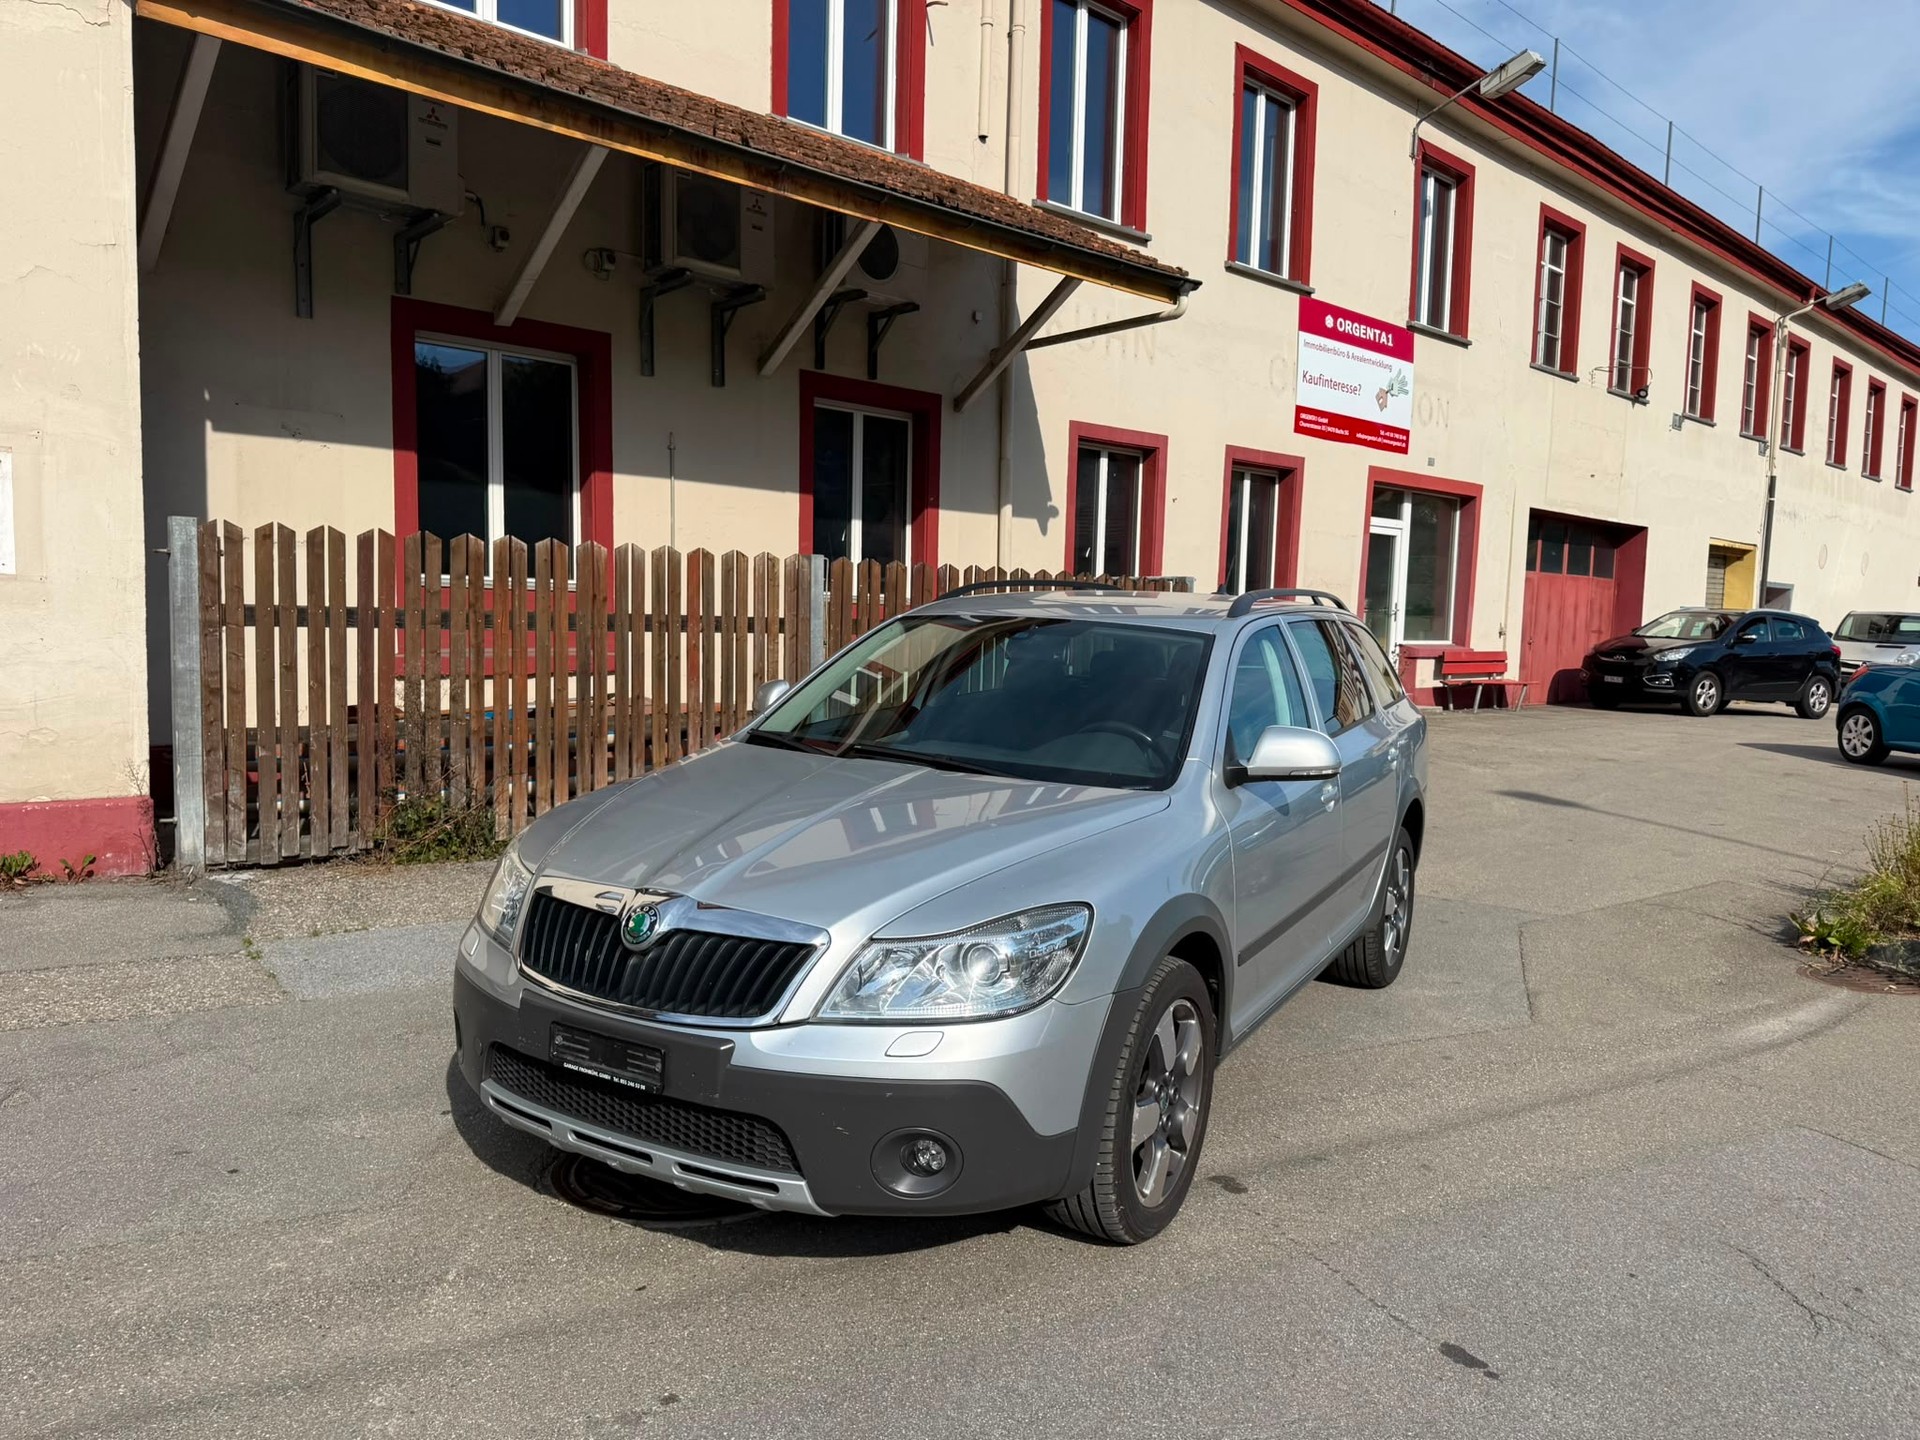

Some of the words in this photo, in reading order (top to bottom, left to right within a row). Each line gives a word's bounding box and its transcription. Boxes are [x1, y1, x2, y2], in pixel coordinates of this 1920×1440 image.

[1336, 317, 1394, 347] ORGENTA1
[1303, 338, 1346, 359] Immobilienbüro
[1351, 352, 1393, 372] Arealentwicklung
[1302, 369, 1362, 396] Kaufinteresse?
[563, 1062, 579, 1072] GARAGE
